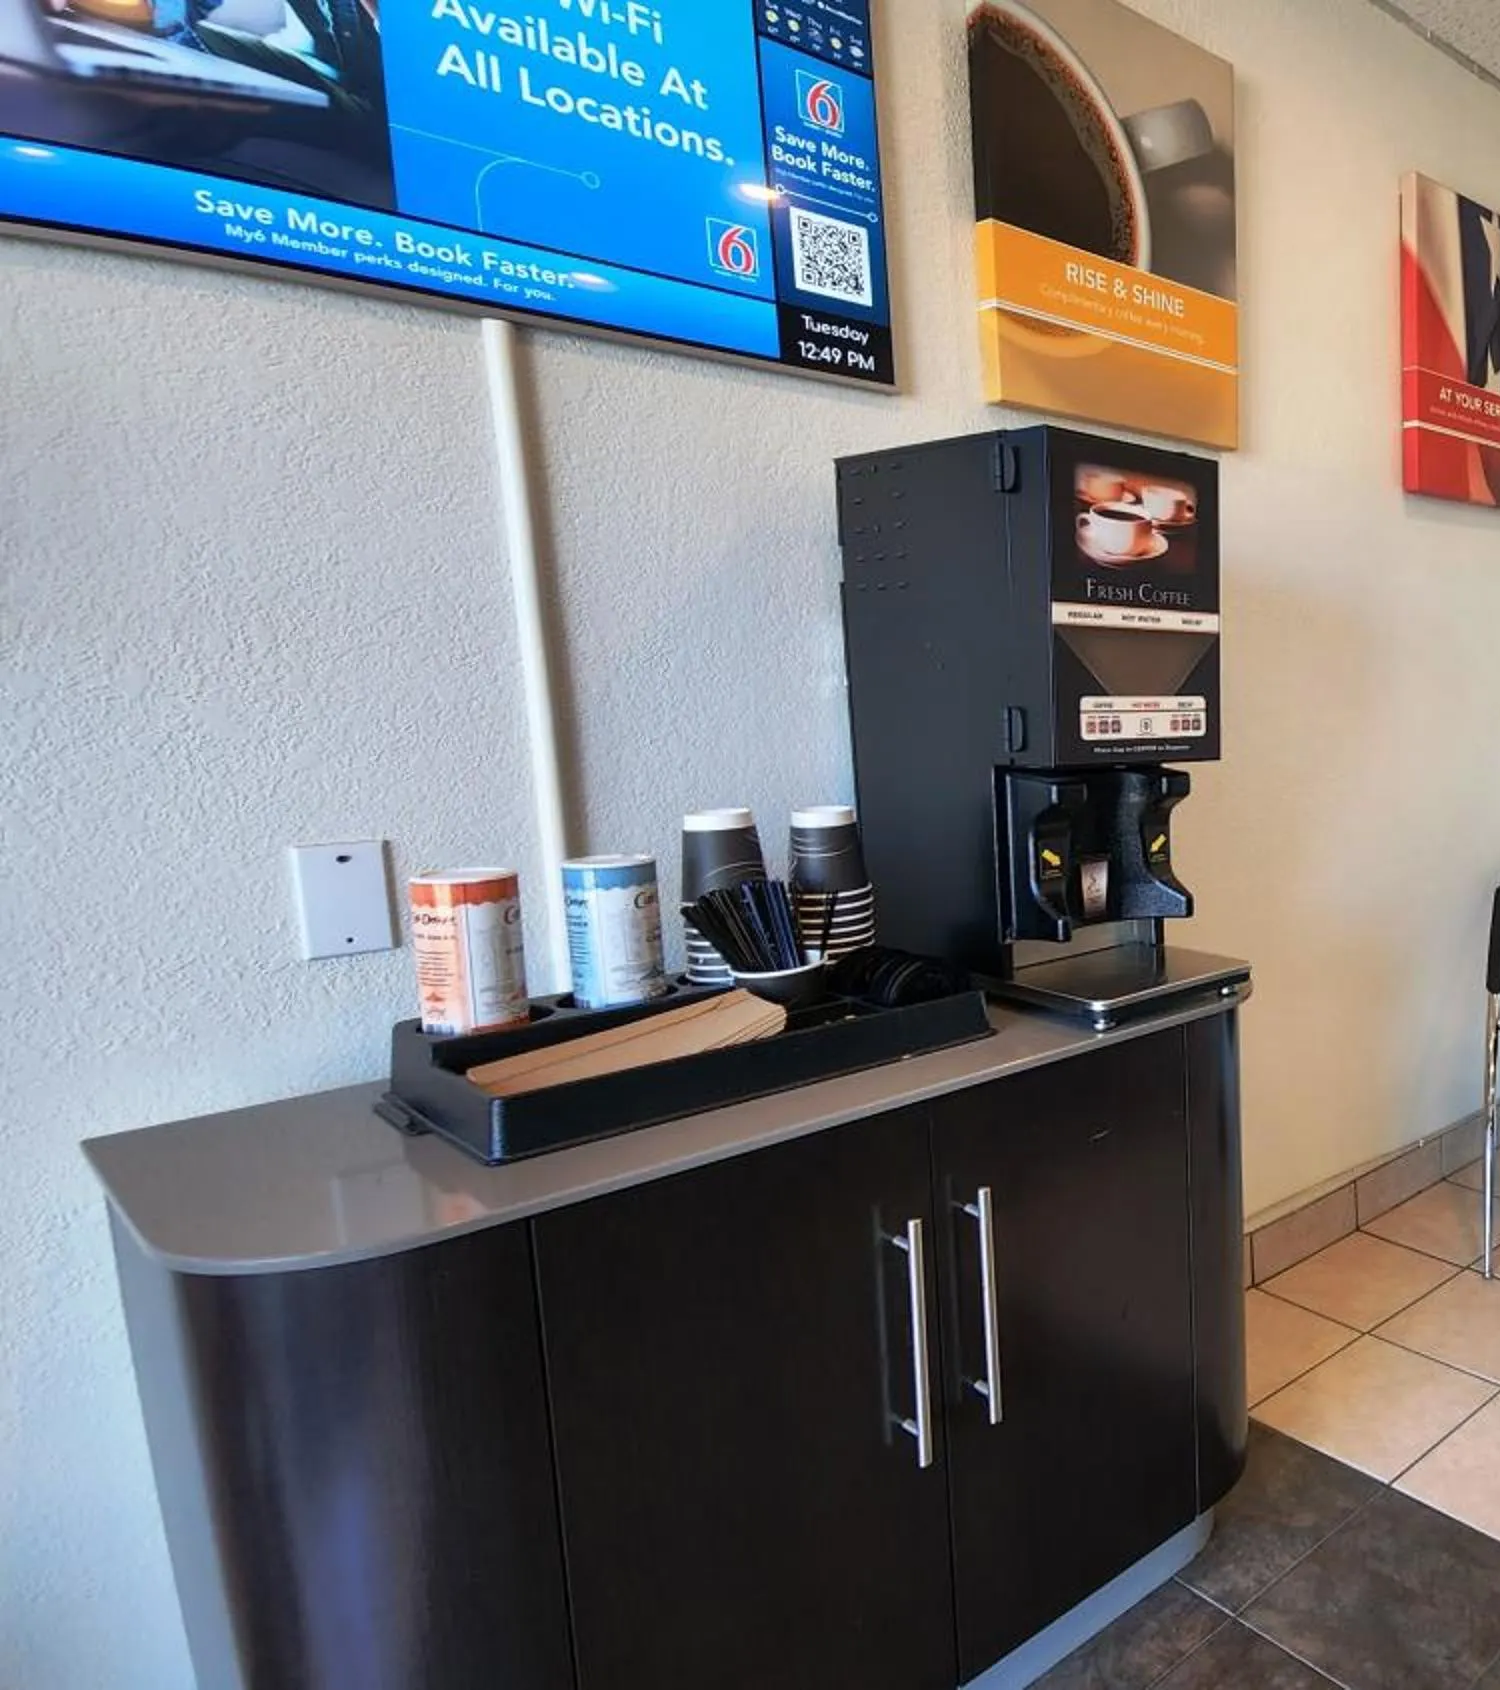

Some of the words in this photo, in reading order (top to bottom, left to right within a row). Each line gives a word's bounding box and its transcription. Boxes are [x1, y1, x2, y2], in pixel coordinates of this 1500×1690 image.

[431, 0, 647, 87] Available
[659, 67, 709, 110] At
[436, 44, 502, 93] All
[518, 66, 736, 167] Locations.
[771, 144, 818, 173] Book
[821, 161, 876, 193] Faster.
[774, 125, 817, 153] Save
[821, 141, 870, 172] More.
[194, 189, 274, 226] Save
[287, 206, 384, 248] More.
[395, 230, 474, 267] Book
[482, 251, 576, 289] Faster.
[224, 222, 267, 243] My6
[271, 231, 349, 260] Member
[354, 250, 402, 269] perks
[407, 258, 487, 288] designed.
[493, 276, 520, 293] For
[718, 225, 755, 276] 6
[1065, 262, 1108, 293] RISE
[1113, 277, 1128, 299] &
[1132, 284, 1185, 318] SHINE
[801, 314, 870, 346] Tuesday
[797, 341, 842, 364] 12:49
[846, 350, 876, 372] PM
[1440, 385, 1453, 402] AT
[1455, 391, 1483, 413] YOUR
[1086, 577, 1133, 601] FRESH
[1139, 582, 1193, 606] COFFEE
